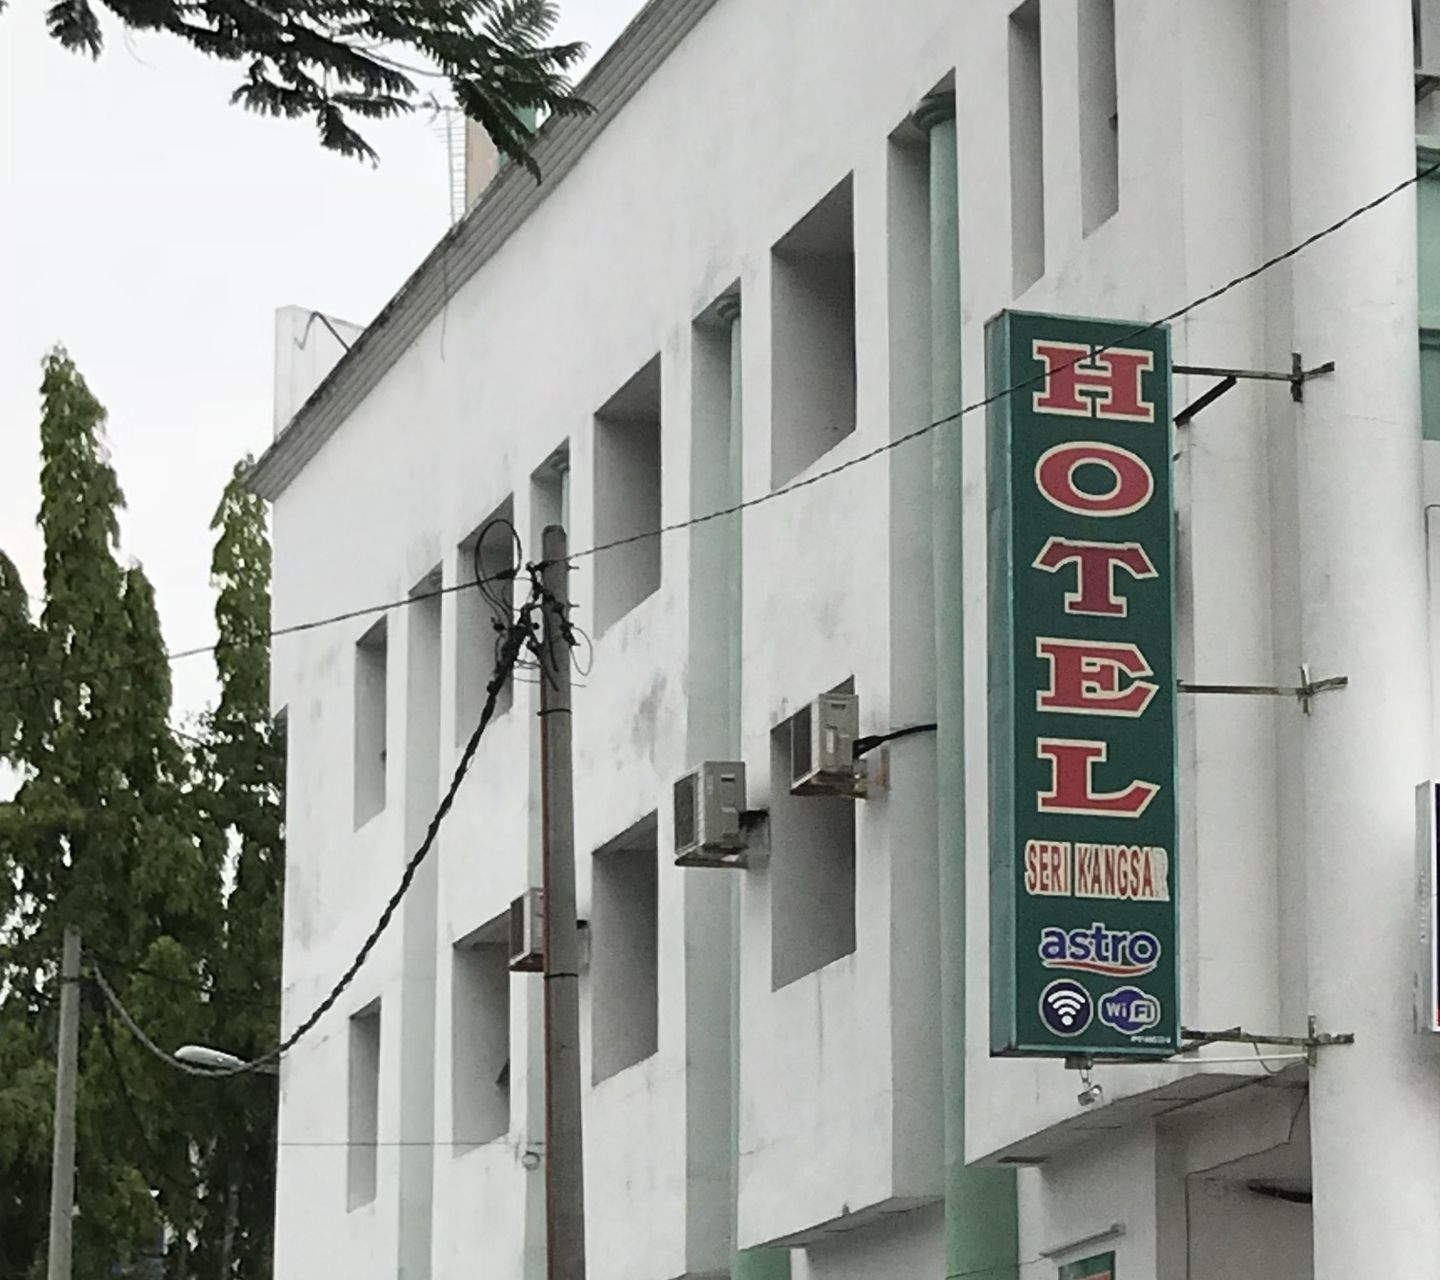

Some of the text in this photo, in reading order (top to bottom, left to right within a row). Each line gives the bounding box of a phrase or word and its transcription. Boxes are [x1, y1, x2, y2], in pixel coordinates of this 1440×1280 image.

[1032, 339, 1160, 819] HOTEL
[1025, 840, 1071, 896] SERI
[1039, 922, 1161, 967] astro
